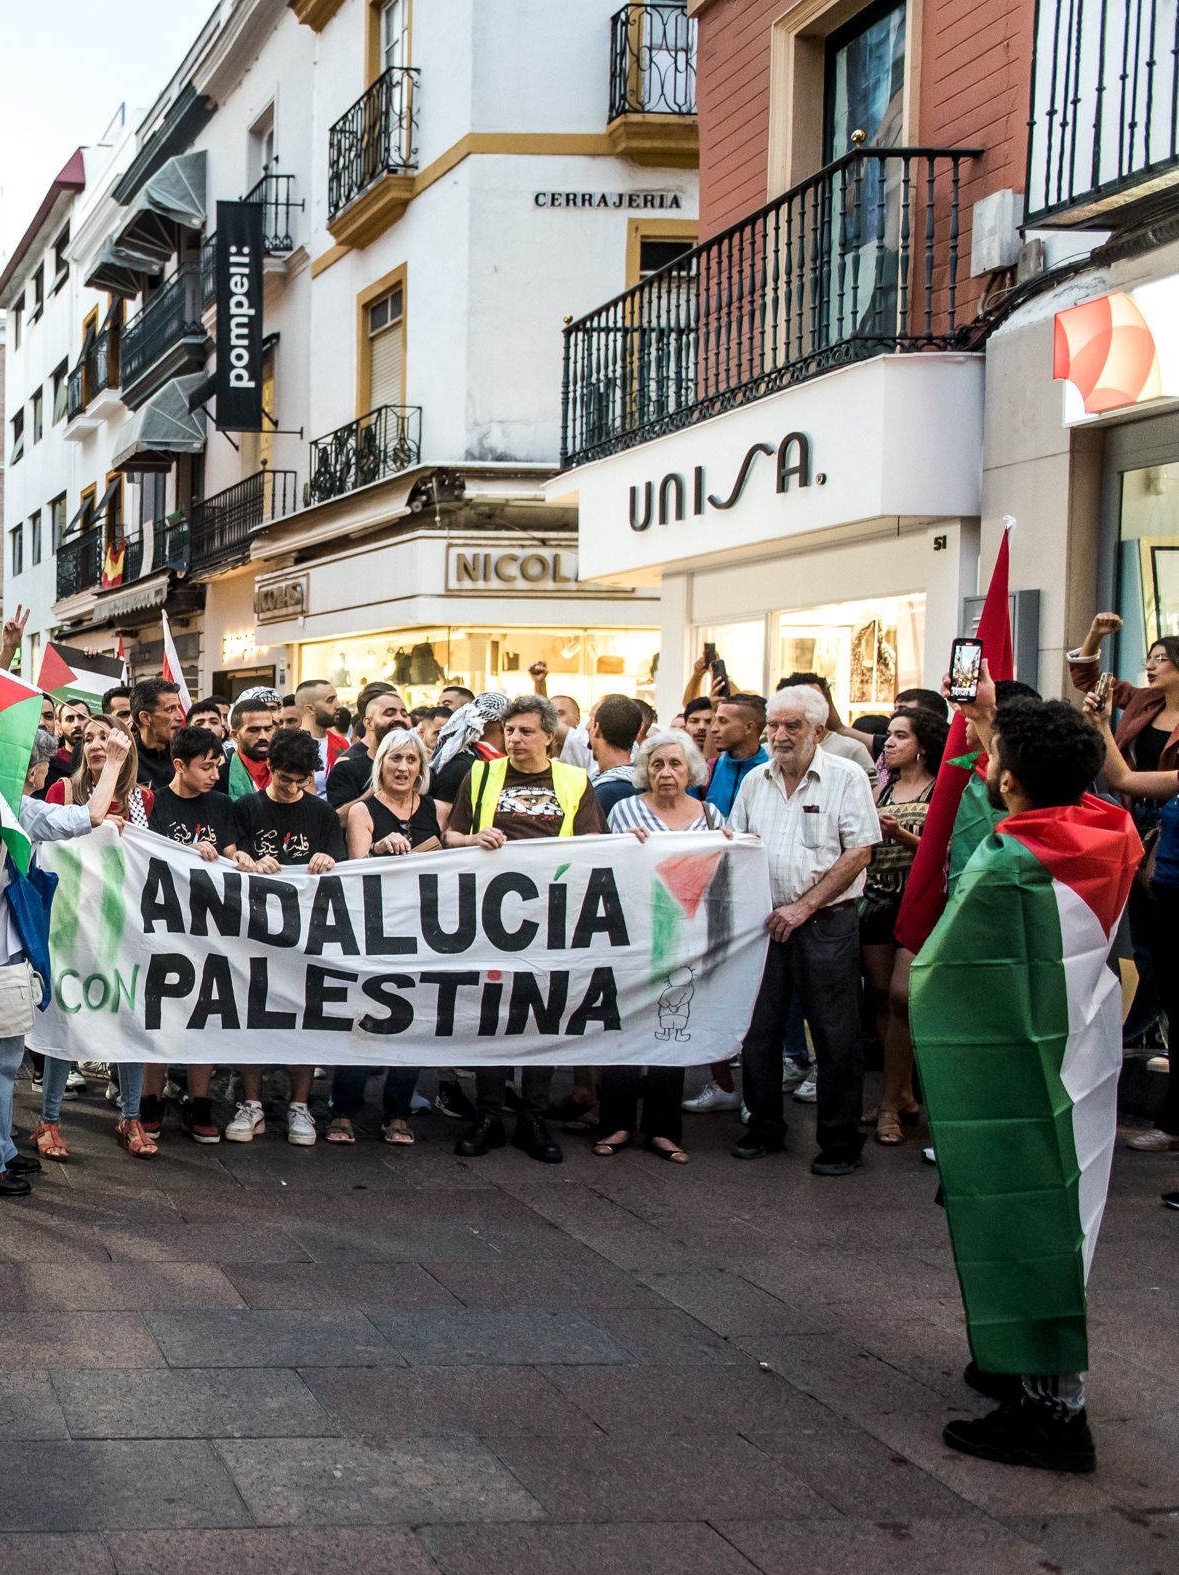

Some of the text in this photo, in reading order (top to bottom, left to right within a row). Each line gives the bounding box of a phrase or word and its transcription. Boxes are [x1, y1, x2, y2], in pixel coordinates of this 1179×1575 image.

[534, 192, 681, 209] CERRAJERIA
[933, 535, 947, 550] 51
[456, 553, 578, 583] NICOL
[55, 963, 144, 1015] CON
